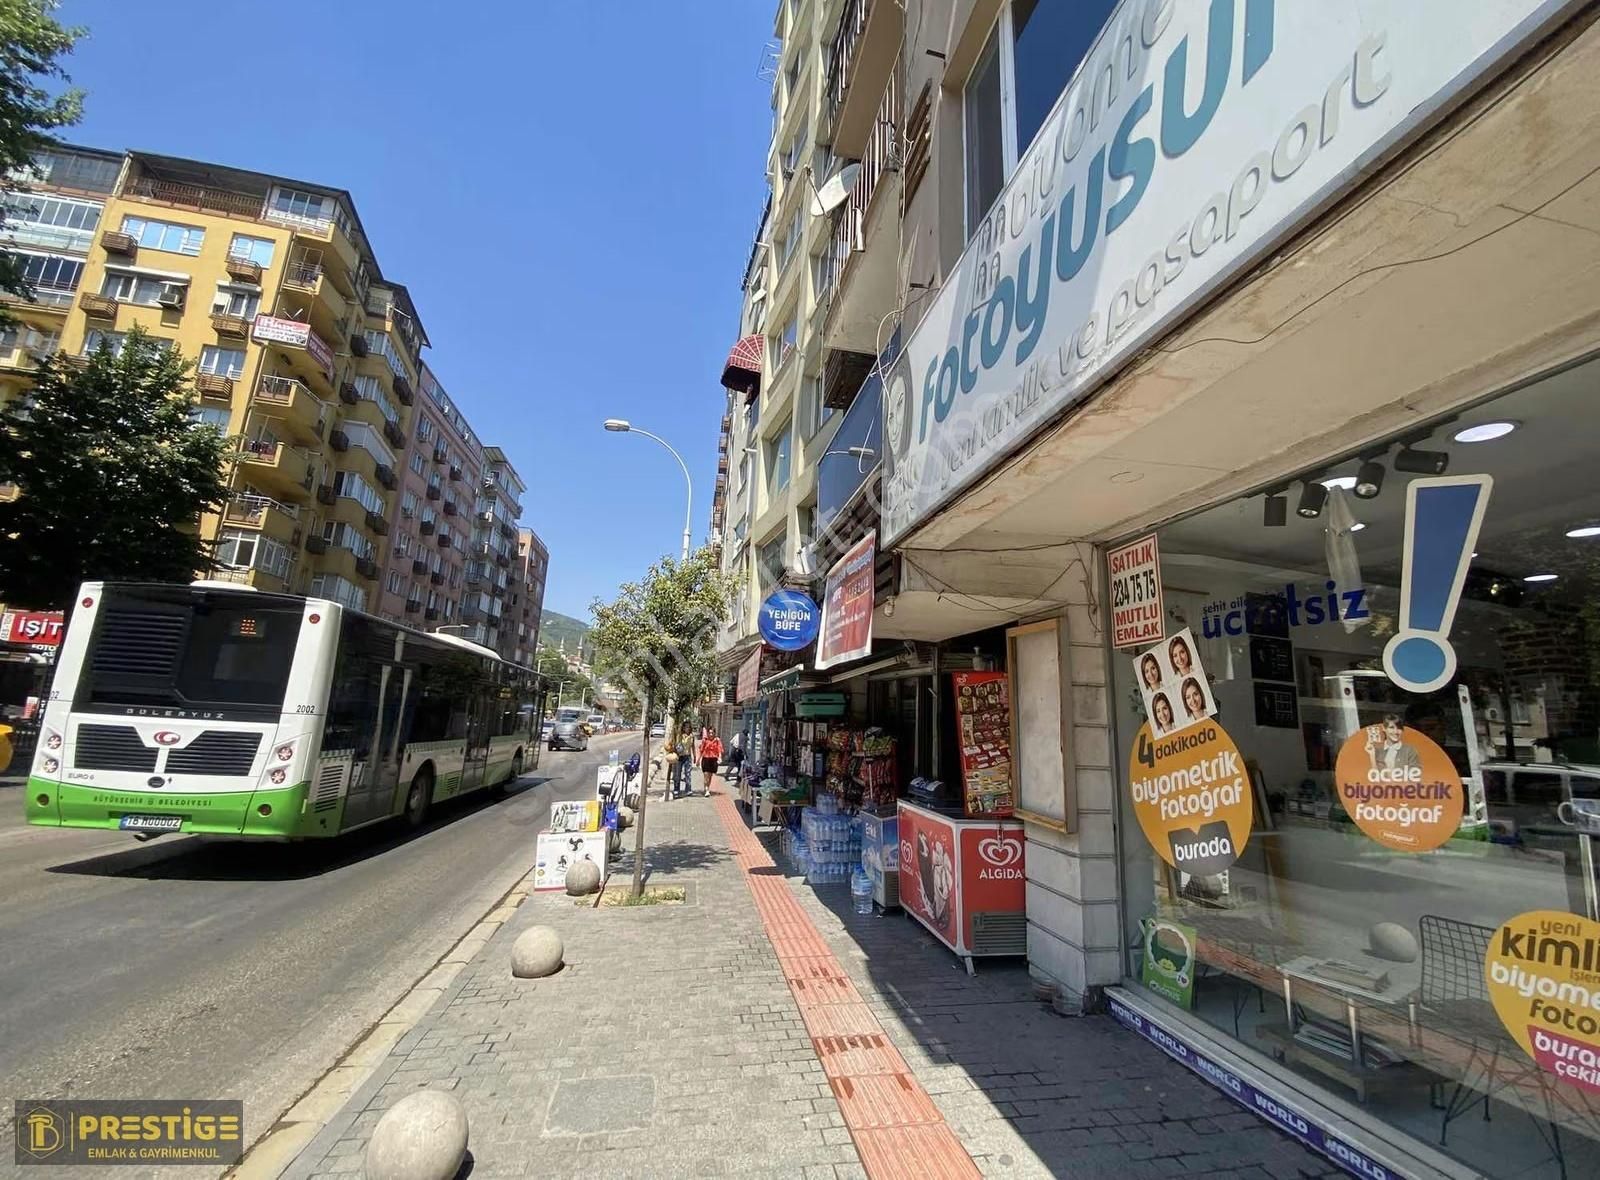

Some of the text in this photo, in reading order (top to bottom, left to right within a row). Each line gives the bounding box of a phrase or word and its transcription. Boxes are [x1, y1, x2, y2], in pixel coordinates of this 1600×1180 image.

[1058, 311, 1100, 376] ve
[1106, 30, 1392, 346] pasaport
[1111, 543, 1154, 575] SATILIK
[1113, 568, 1157, 608] 234 75 75
[768, 608, 811, 621] YENİGÜN
[775, 620, 801, 631] BÜFE
[1115, 602, 1158, 626] MUTLU
[1202, 580, 1369, 640] ücrtsiz
[1117, 621, 1160, 642] EMLAK
[296, 704, 315, 714] 2002
[1138, 727, 1217, 769] 4 dakikada
[1132, 751, 1240, 805] biyometrik
[1367, 764, 1422, 783] acele
[1160, 778, 1243, 821] fotoğraf
[1343, 781, 1453, 803] biyometrik
[1355, 803, 1443, 827] fotoğraf
[1175, 836, 1231, 861] burada
[1540, 919, 1582, 937] yeni
[1110, 1000, 1142, 1027] WORLD
[1529, 998, 1600, 1036] foto
[1150, 1025, 1187, 1057] WORLD
[1196, 1056, 1242, 1093] WORLD
[1255, 1092, 1309, 1135] WORLD
[1325, 1138, 1386, 1180] WORLD
